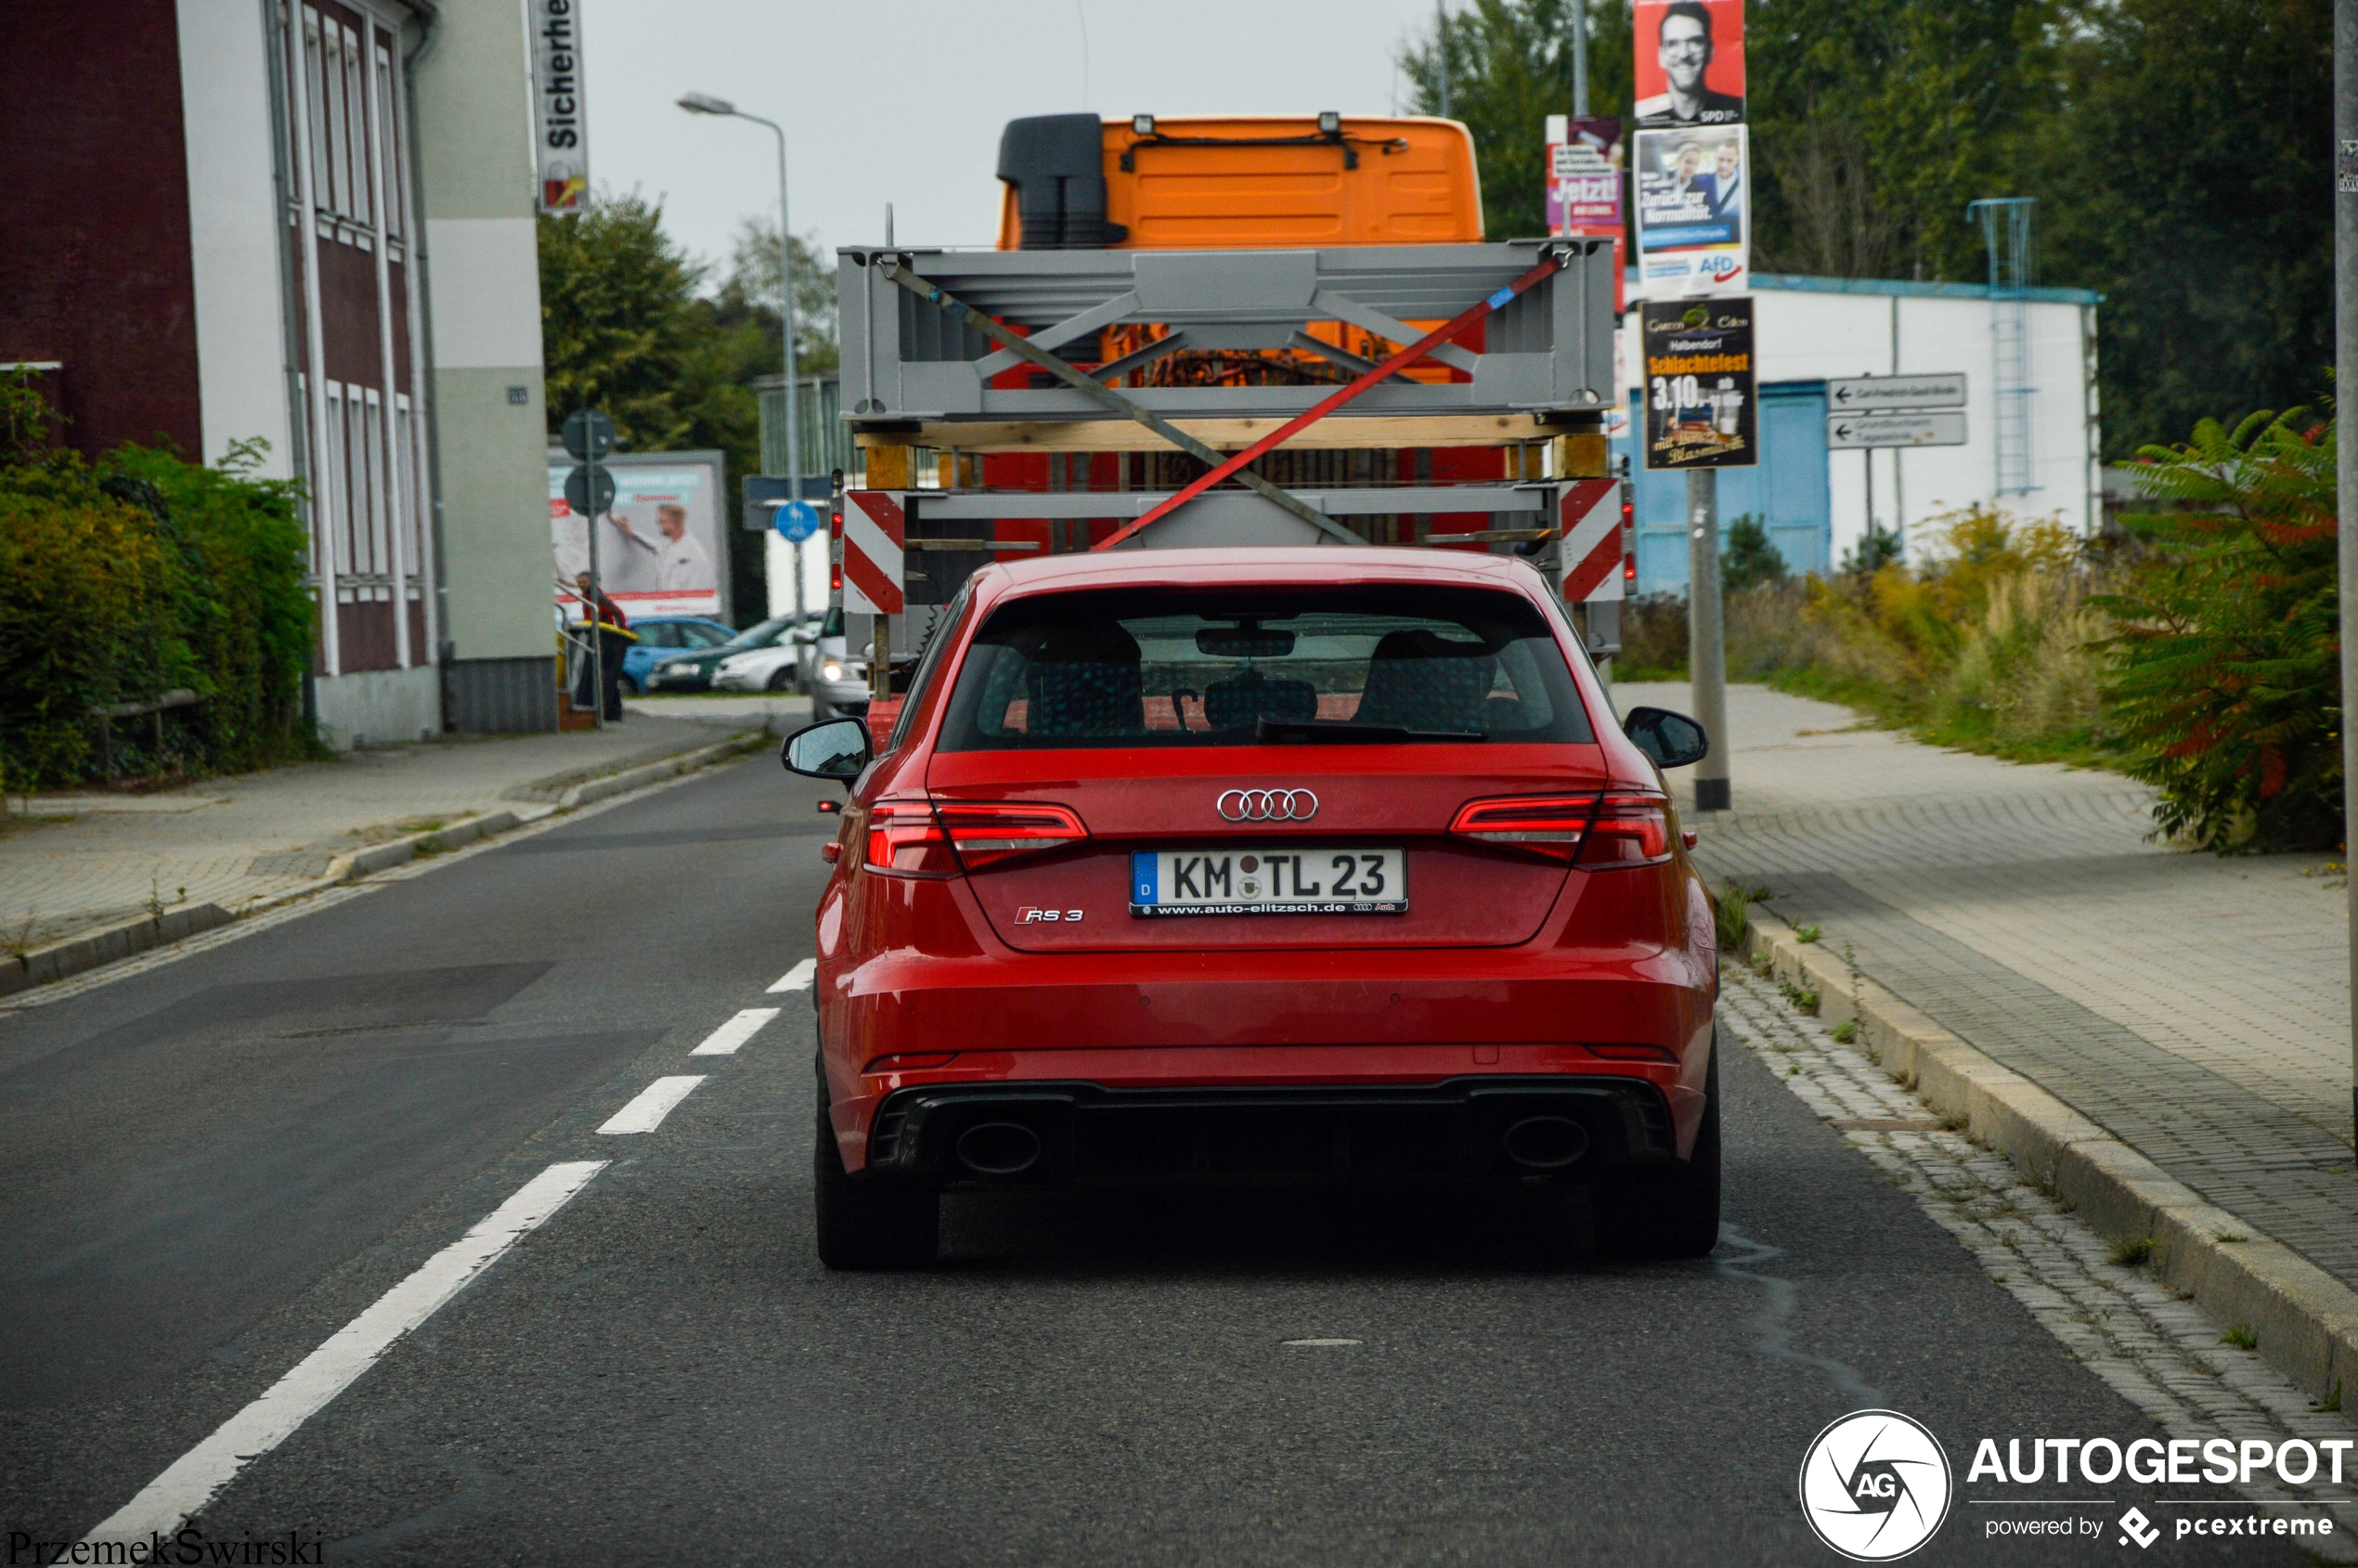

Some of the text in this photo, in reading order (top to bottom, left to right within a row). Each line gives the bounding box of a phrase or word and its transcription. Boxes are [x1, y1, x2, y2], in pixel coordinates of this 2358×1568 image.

[542, 0, 577, 149] Sicherhe
[1700, 110, 1724, 123] SPD
[1553, 178, 1617, 202] Jetzt!
[1640, 191, 1706, 208] Zurück zur
[1644, 206, 1713, 223] Normalität.
[1700, 256, 1733, 273] AfD
[1670, 339, 1723, 352] Halbendorf
[1650, 355, 1749, 375] Schlachtefest
[1653, 376, 1704, 409] 3.10.
[1174, 855, 1384, 899] KM TL 23
[1141, 885, 1150, 896] D
[1024, 910, 1083, 922] RS 3
[1158, 903, 1346, 915] www.auto-elitzsch.de
